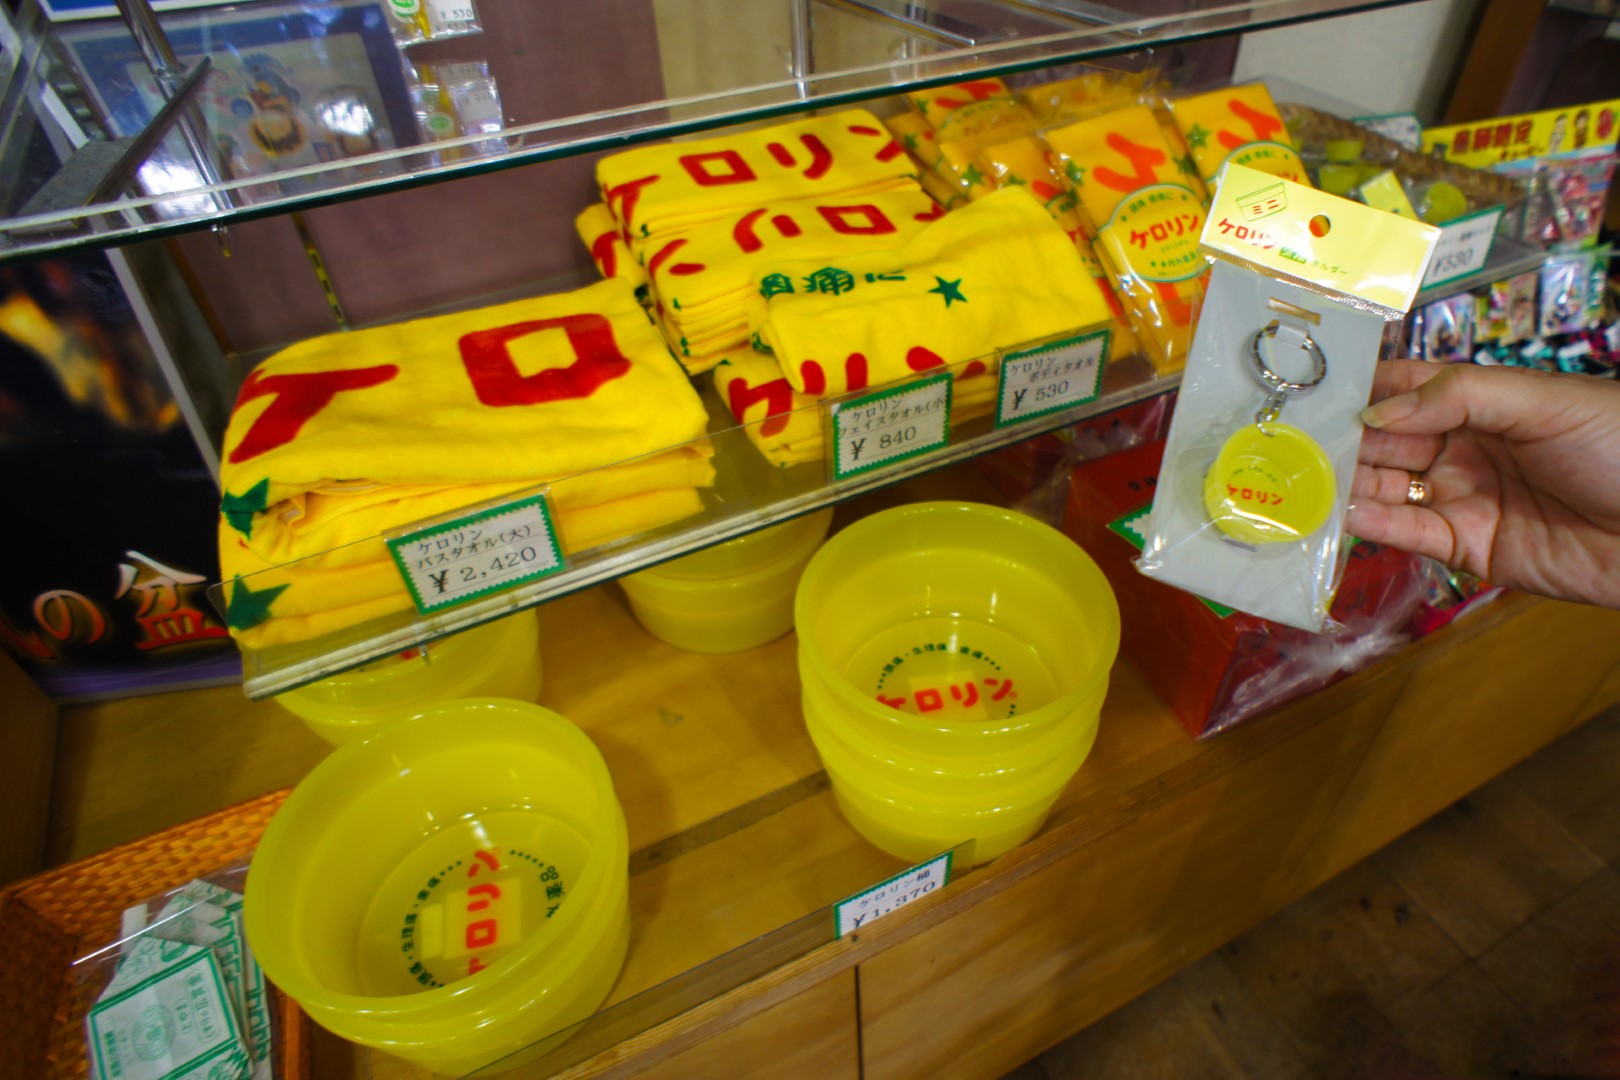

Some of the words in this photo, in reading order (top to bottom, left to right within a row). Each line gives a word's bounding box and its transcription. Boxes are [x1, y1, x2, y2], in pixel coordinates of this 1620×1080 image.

[453, 8, 472, 18] 530
[1129, 214, 1199, 250] ケロリン
[1011, 356, 1056, 376] ケロリン
[1035, 380, 1069, 401] 530
[852, 399, 902, 422] ケロリン
[880, 425, 916, 449] 840
[1226, 484, 1284, 505] ケロリン
[418, 528, 483, 555] ケロリン
[460, 546, 537, 582] 2,420
